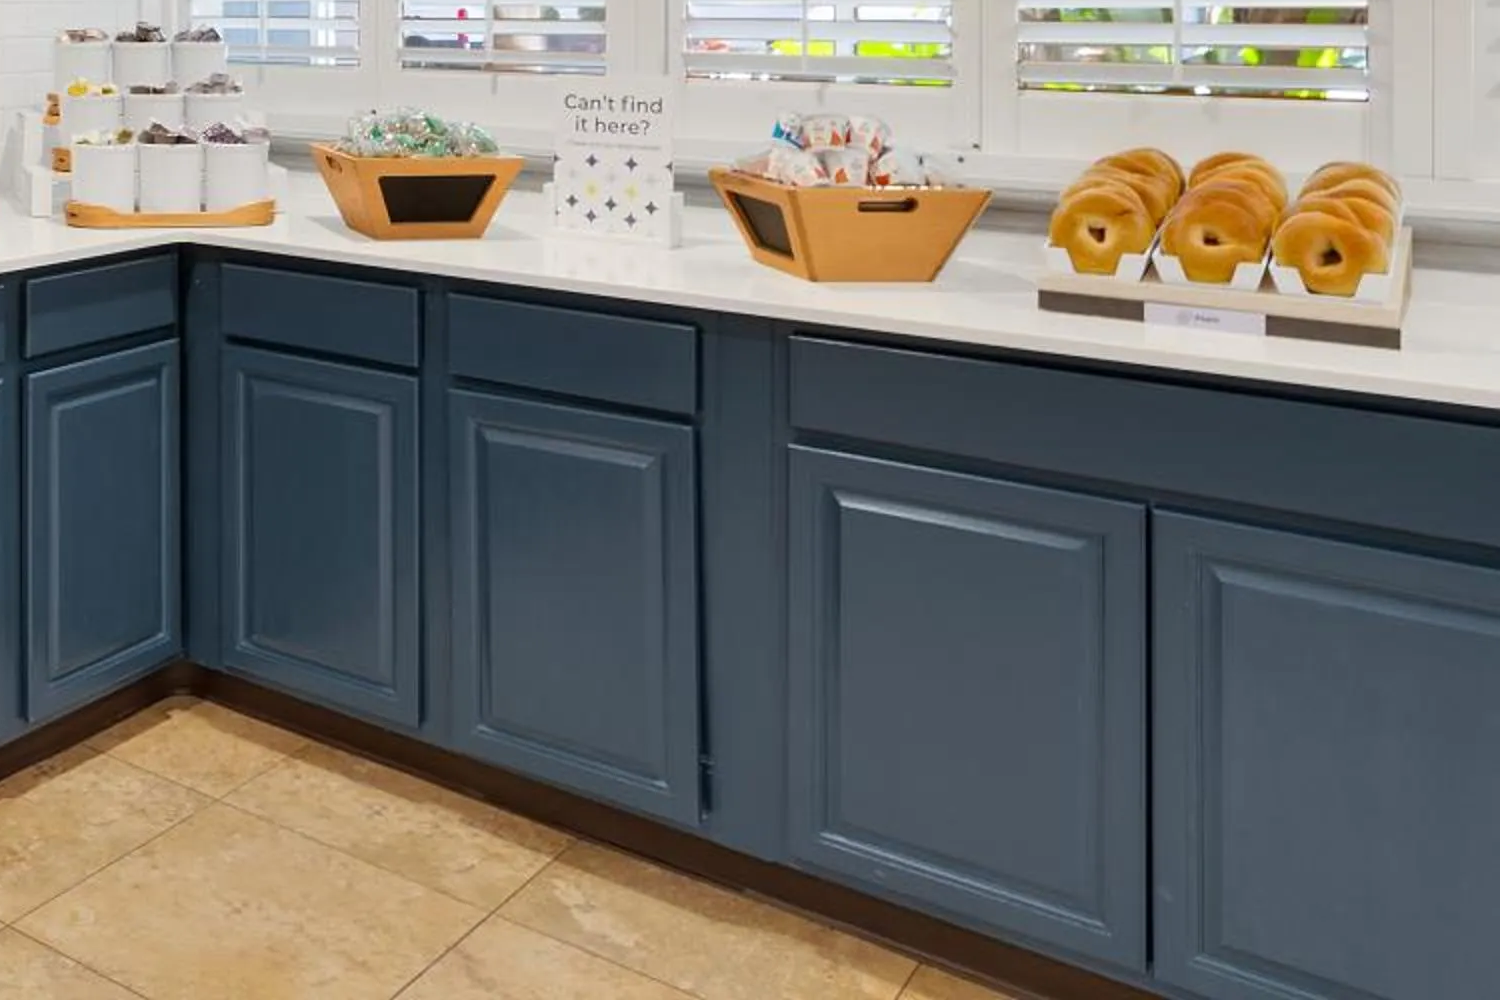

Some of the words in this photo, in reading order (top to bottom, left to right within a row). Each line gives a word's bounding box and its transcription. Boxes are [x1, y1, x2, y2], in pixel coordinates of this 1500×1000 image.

[564, 93, 615, 112] Can't
[621, 95, 663, 114] find
[575, 116, 588, 132] it
[595, 117, 651, 136] here?
